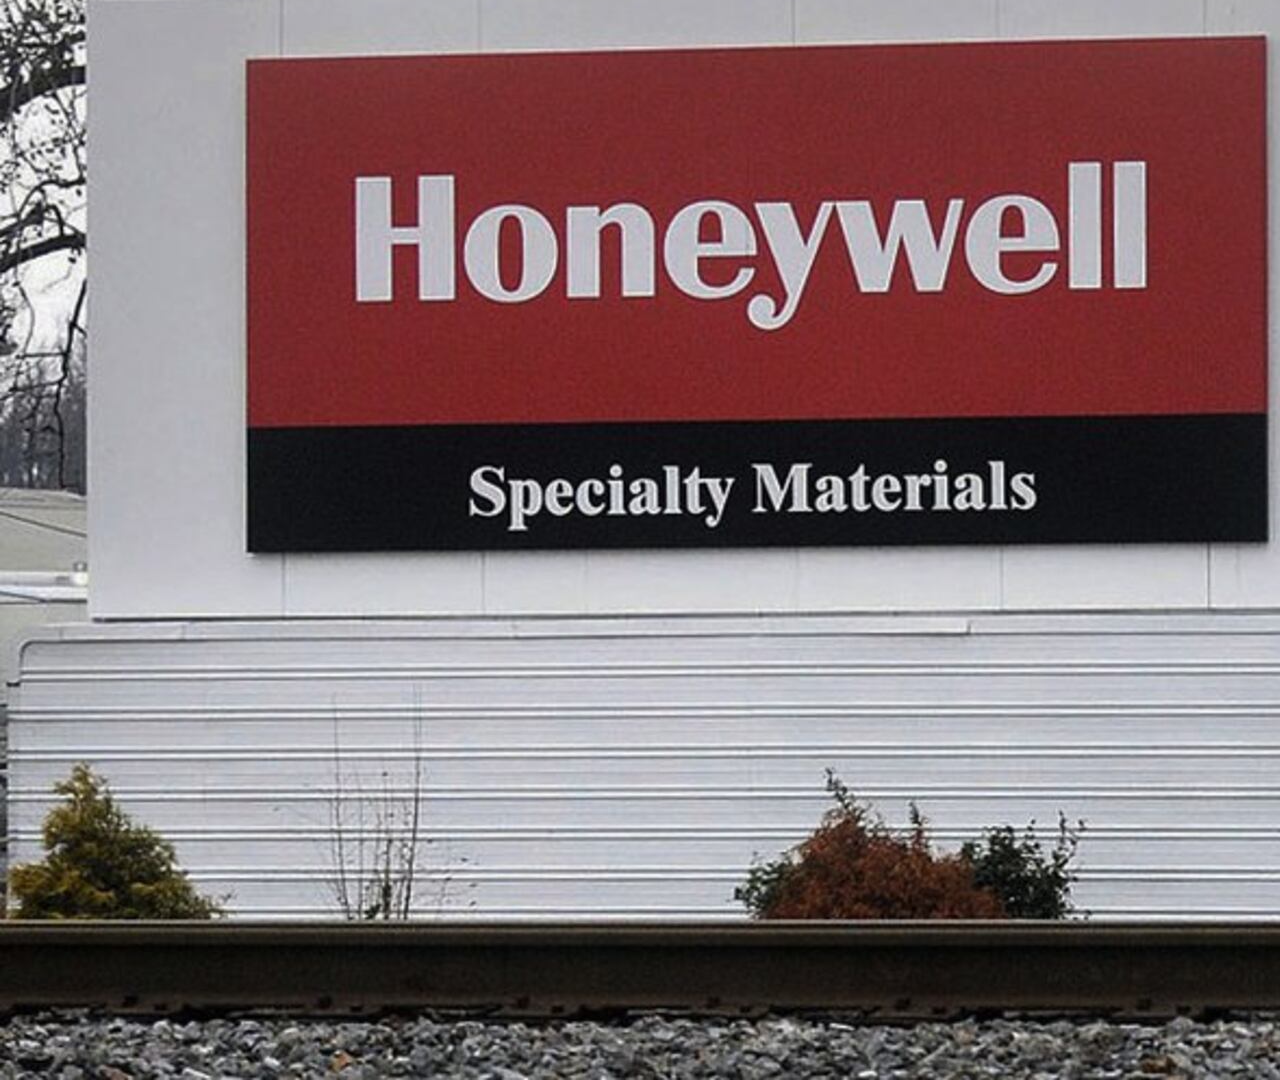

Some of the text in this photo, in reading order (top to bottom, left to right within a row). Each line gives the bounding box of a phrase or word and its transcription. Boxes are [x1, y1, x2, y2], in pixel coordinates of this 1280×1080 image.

[354, 160, 1148, 331] Honeywell
[468, 459, 1038, 532] Specialty Materials
